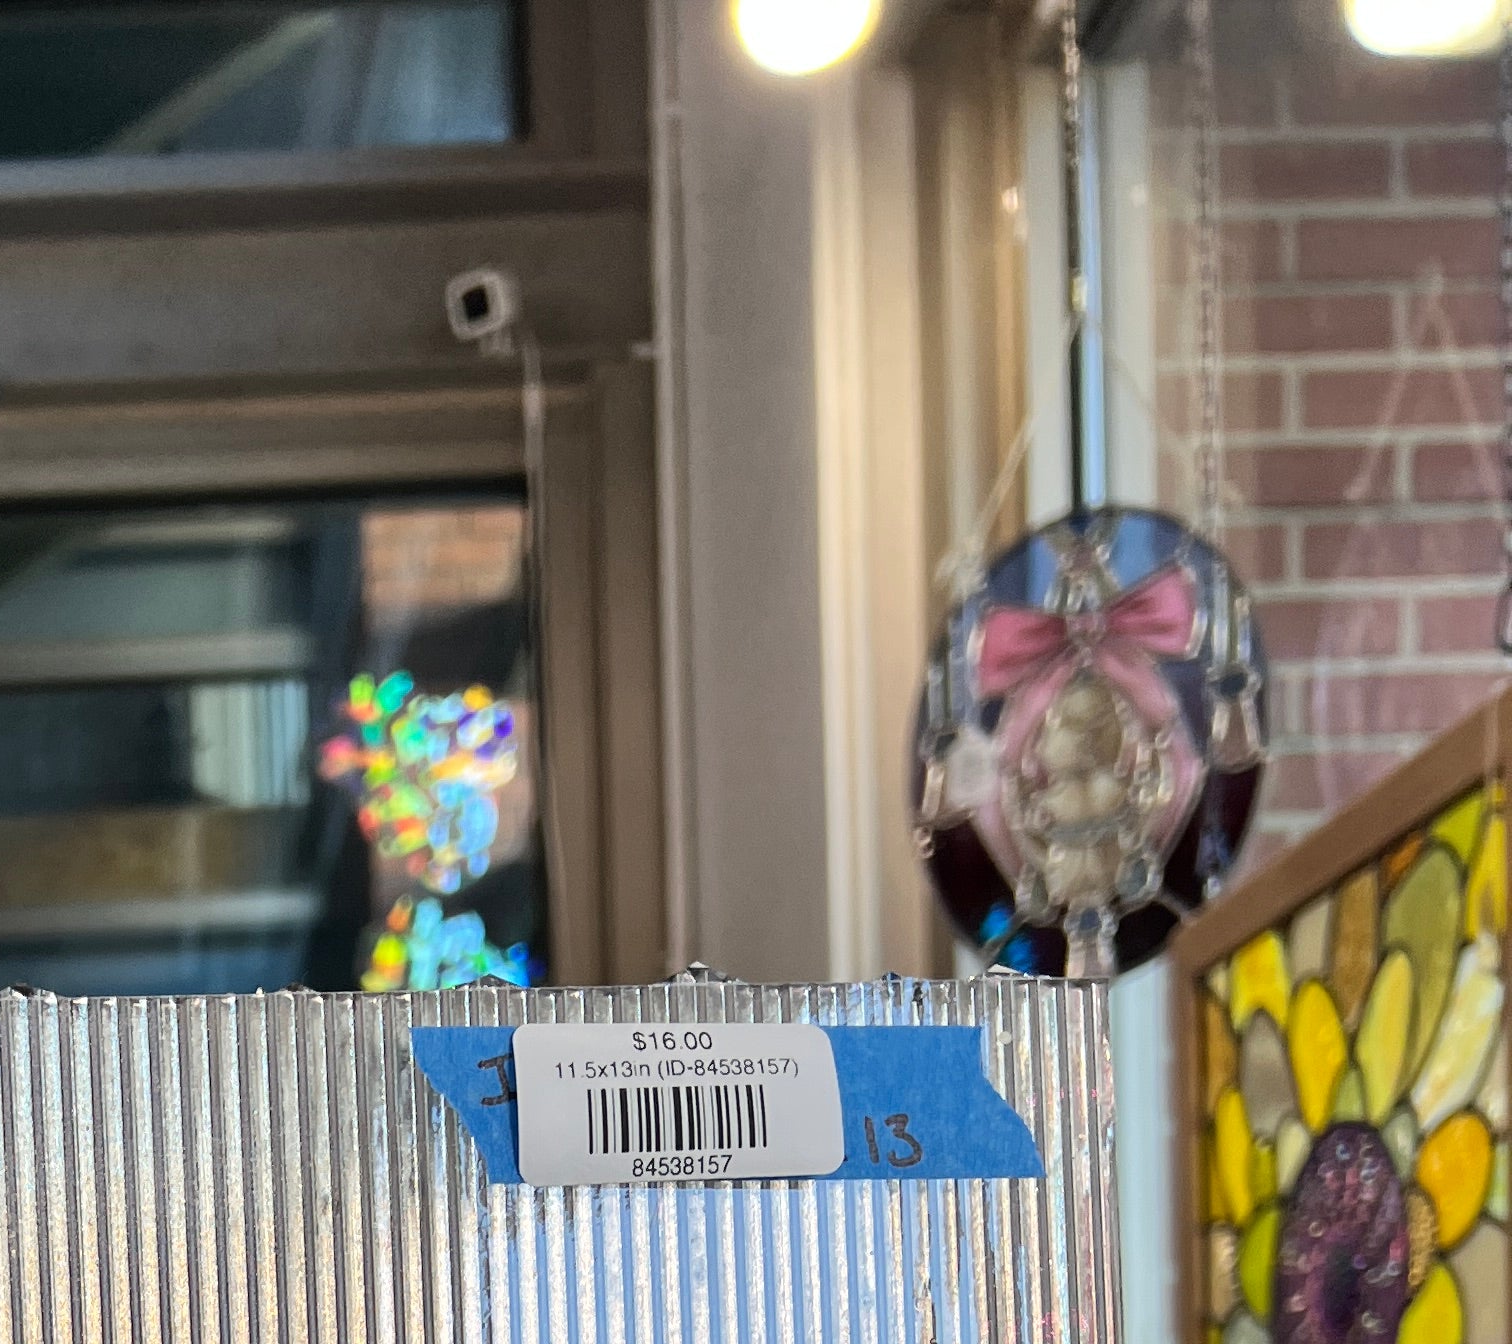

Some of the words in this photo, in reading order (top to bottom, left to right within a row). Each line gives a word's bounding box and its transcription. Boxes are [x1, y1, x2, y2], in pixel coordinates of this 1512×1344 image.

[632, 1031, 713, 1051] $16.00
[554, 1060, 651, 1079] 11.5x13in
[657, 1057, 800, 1080] (ID-84538157)
[864, 1113, 924, 1168] 13
[631, 1154, 733, 1178] 84538157
